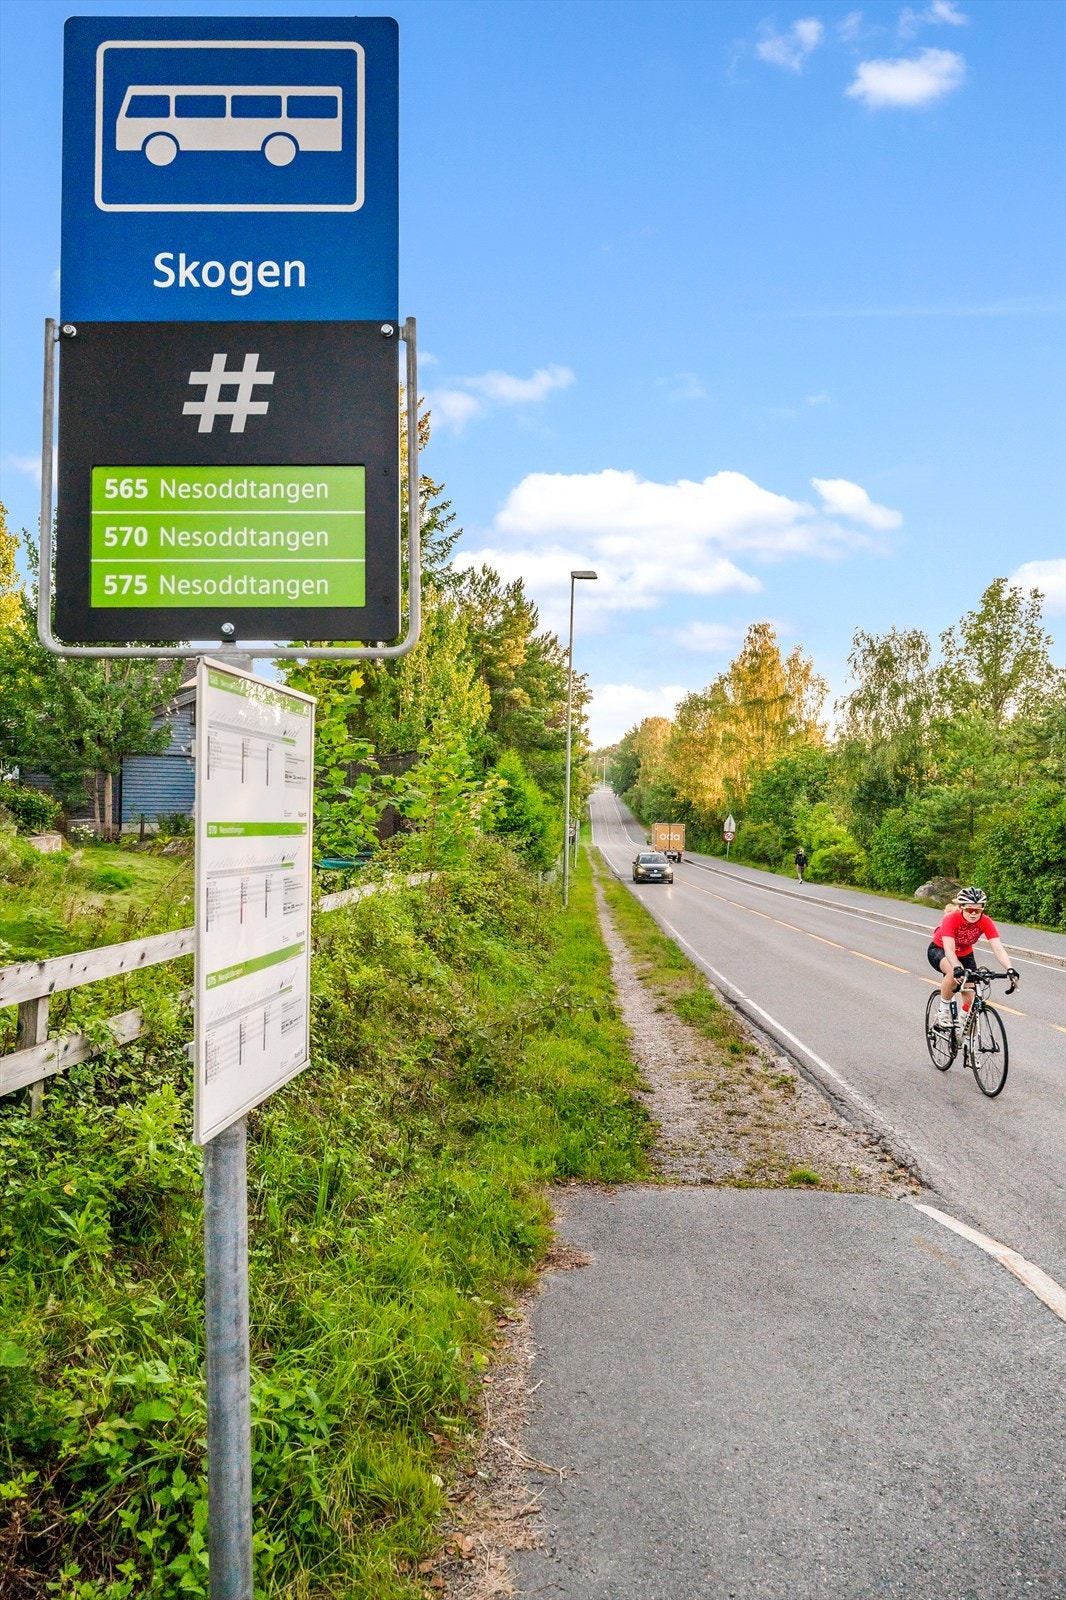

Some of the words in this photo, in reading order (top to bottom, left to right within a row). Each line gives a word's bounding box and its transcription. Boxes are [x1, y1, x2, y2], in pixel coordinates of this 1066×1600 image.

[153, 251, 307, 297] Skogen
[104, 478, 149, 499] 565
[159, 478, 329, 504] Nesoddtangen
[103, 526, 149, 547] 570
[159, 526, 329, 552] Nesoddtangen
[103, 574, 148, 596] 575
[159, 574, 329, 600] Nesoddtangen
[659, 832, 680, 841] oda
